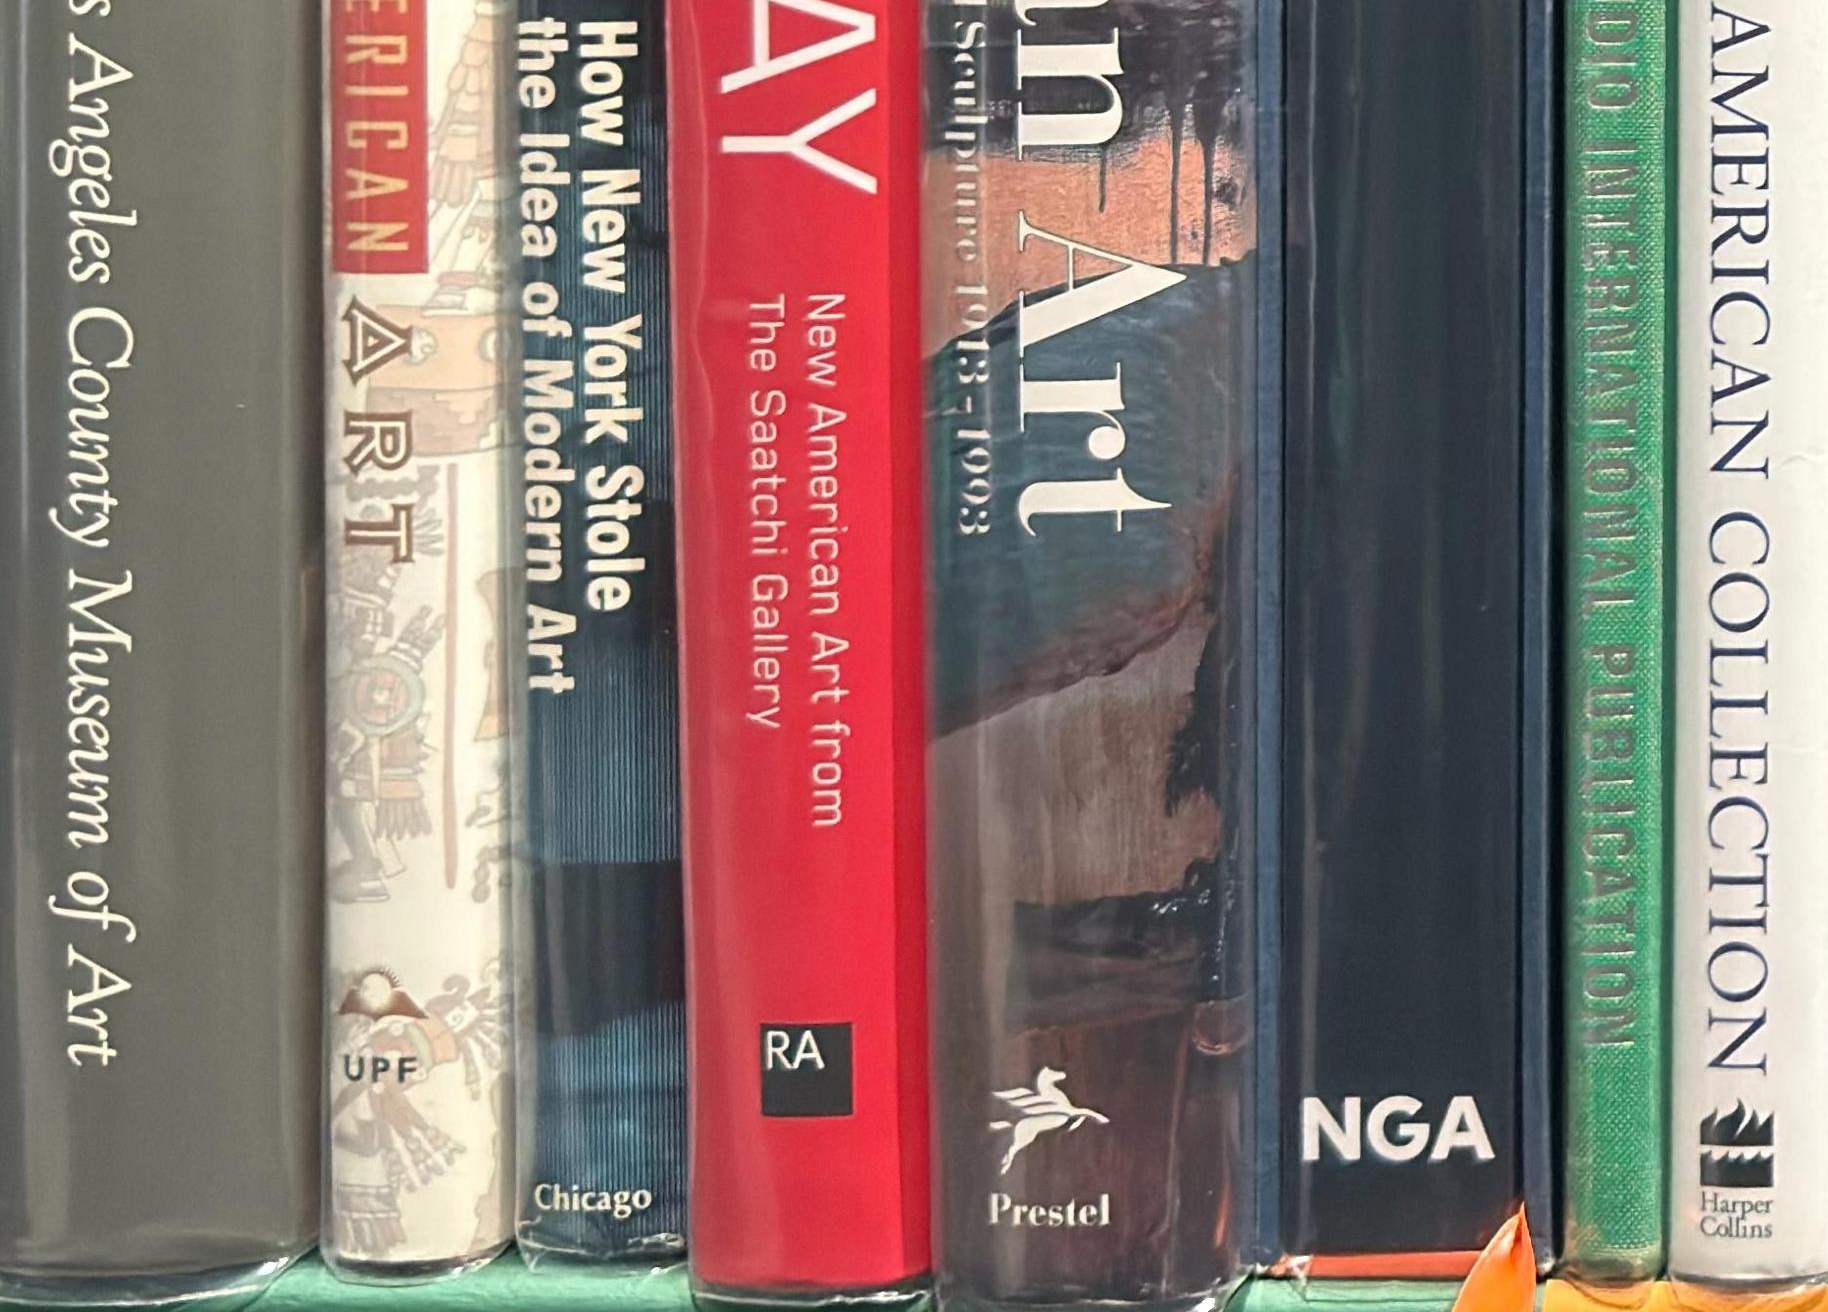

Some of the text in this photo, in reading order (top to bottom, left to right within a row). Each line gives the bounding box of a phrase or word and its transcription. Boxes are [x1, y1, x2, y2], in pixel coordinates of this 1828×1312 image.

[49, 33, 137, 283] Angeles
[1710, 1, 1770, 479] AMERICAN
[49, 307, 133, 547] County
[341, 295, 419, 564] ART
[518, 18, 576, 693] the Idea Modern Art
[579, 22, 645, 610] How New York Stole
[1016, 211, 1189, 537] Art
[746, 294, 788, 728] The Saatchi Gallery
[808, 295, 850, 825] New American Art from
[68, 569, 132, 848] Museum
[1707, 512, 1769, 1075] COLLECTION
[67, 944, 131, 1065] Art
[344, 1054, 416, 1083] UPF
[767, 1030, 824, 1069] RA
[1302, 1096, 1495, 1161] NGA
[535, 1182, 651, 1218] Chicago
[990, 1193, 1109, 1226] Prestel
[1700, 1216, 1772, 1238] Collins
[1702, 1191, 1769, 1220] Harper
